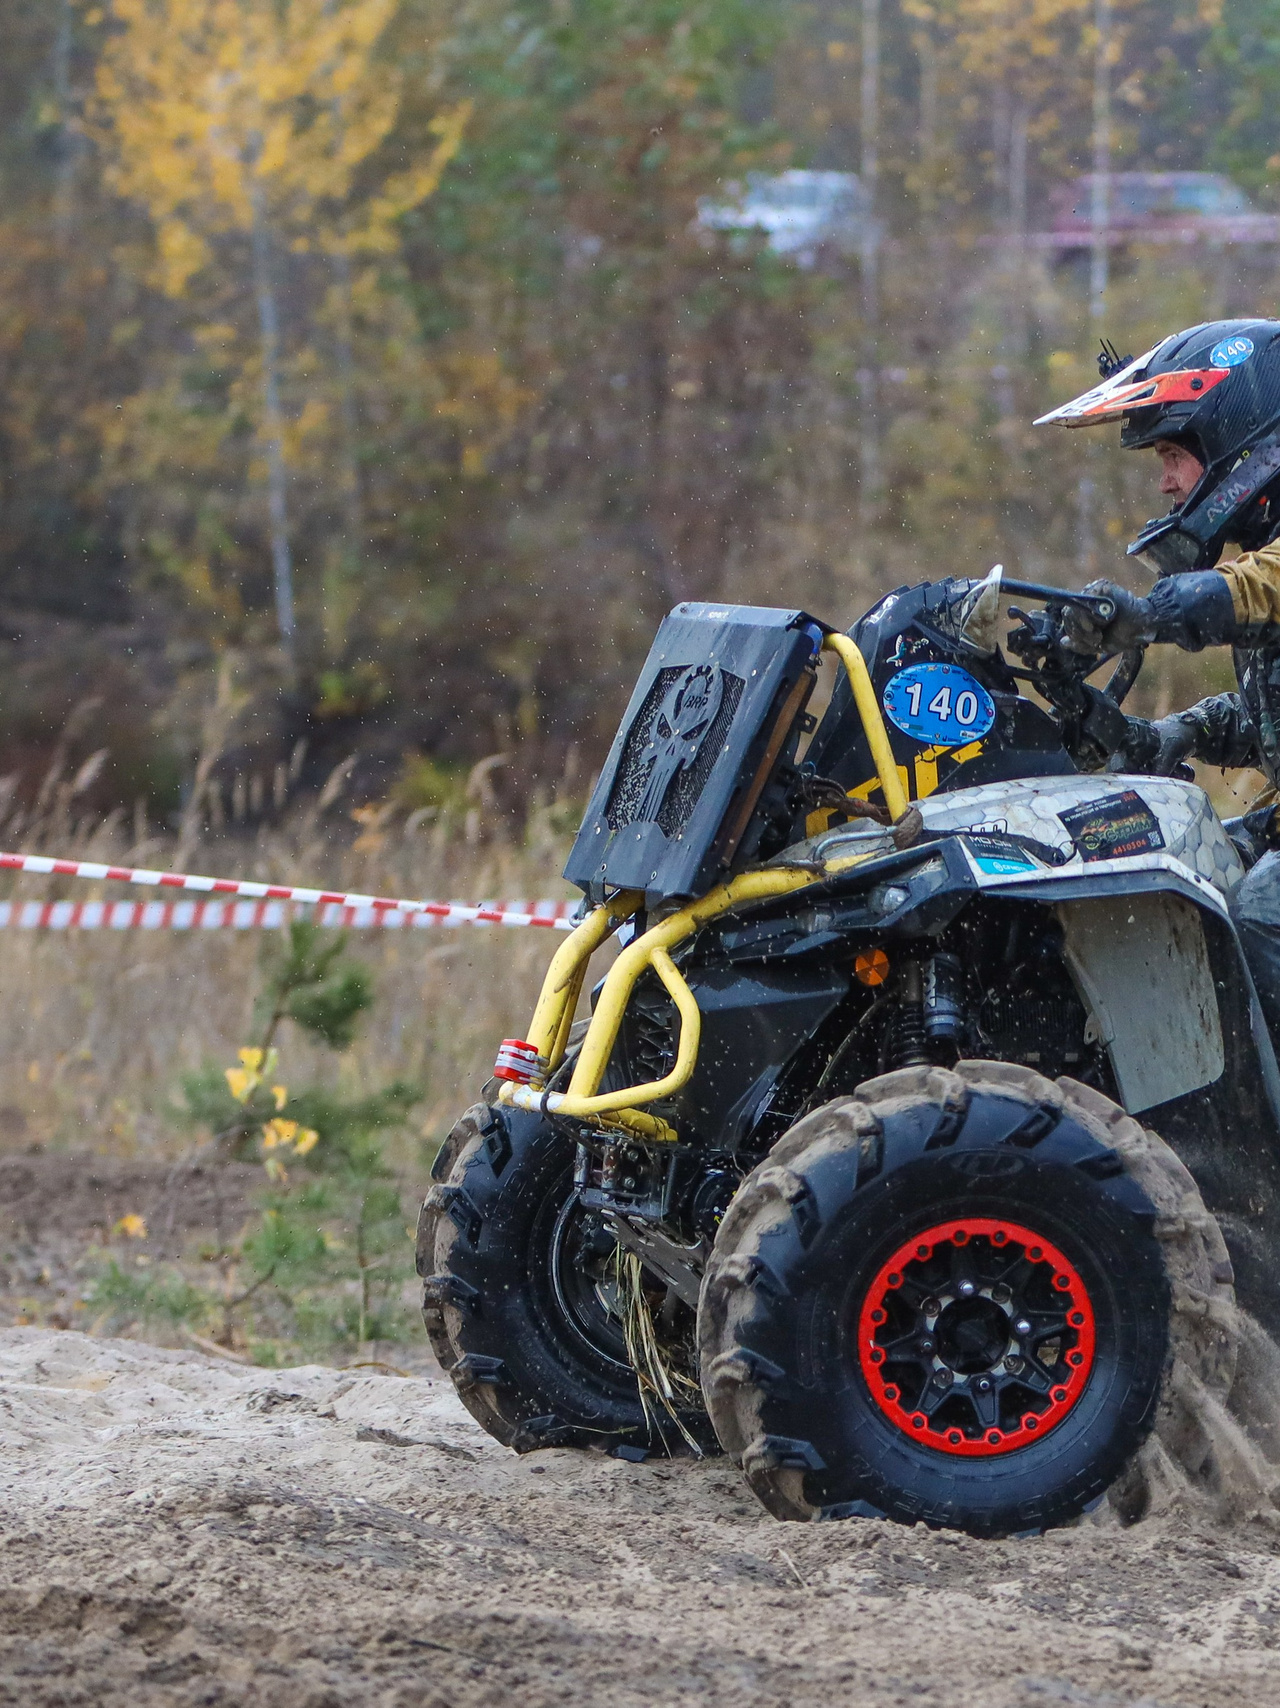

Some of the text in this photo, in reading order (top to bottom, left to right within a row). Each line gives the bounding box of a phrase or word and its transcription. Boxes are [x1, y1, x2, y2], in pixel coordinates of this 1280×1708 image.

[1216, 340, 1247, 361] 140
[683, 693, 710, 711] BRP
[904, 682, 979, 726] 140
